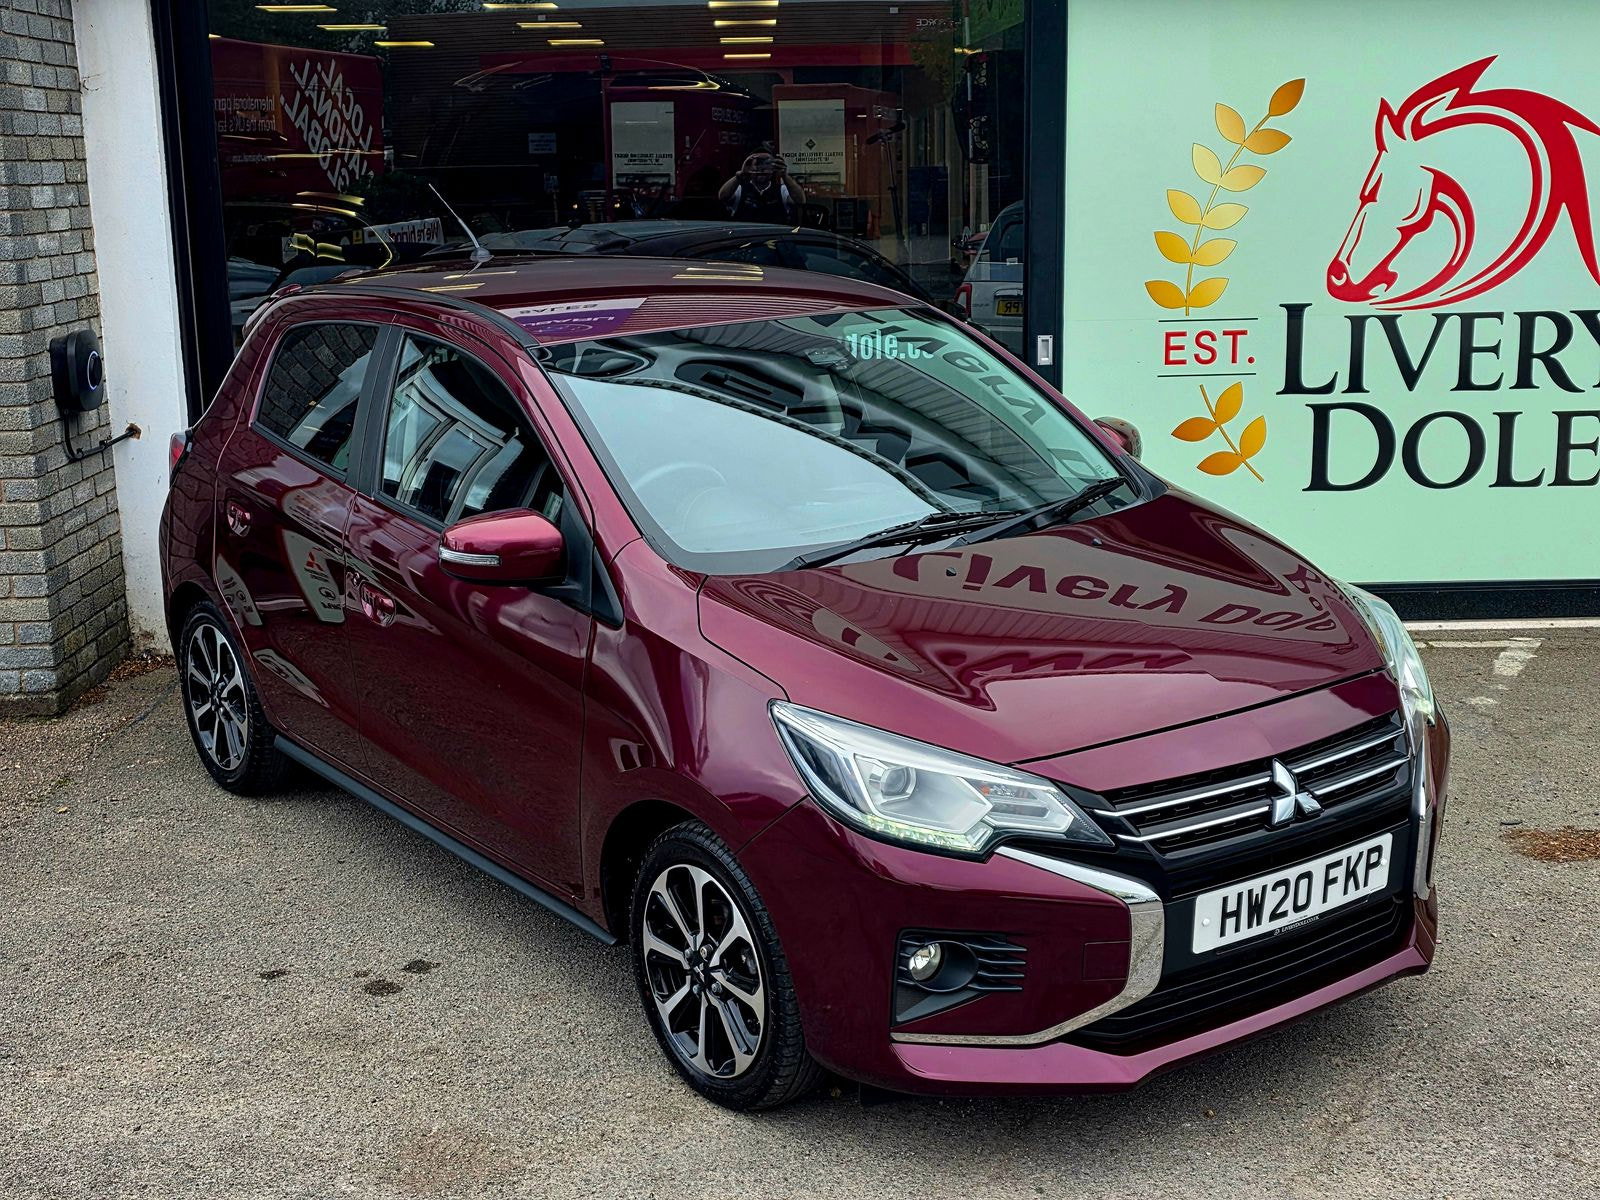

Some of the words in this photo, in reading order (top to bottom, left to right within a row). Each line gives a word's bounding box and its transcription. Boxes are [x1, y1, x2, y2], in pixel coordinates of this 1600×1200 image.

[1163, 329, 1256, 366] EST.
[1302, 402, 1600, 492] DOLE
[1219, 869, 1315, 939] HW20
[1321, 844, 1385, 905] FKP
